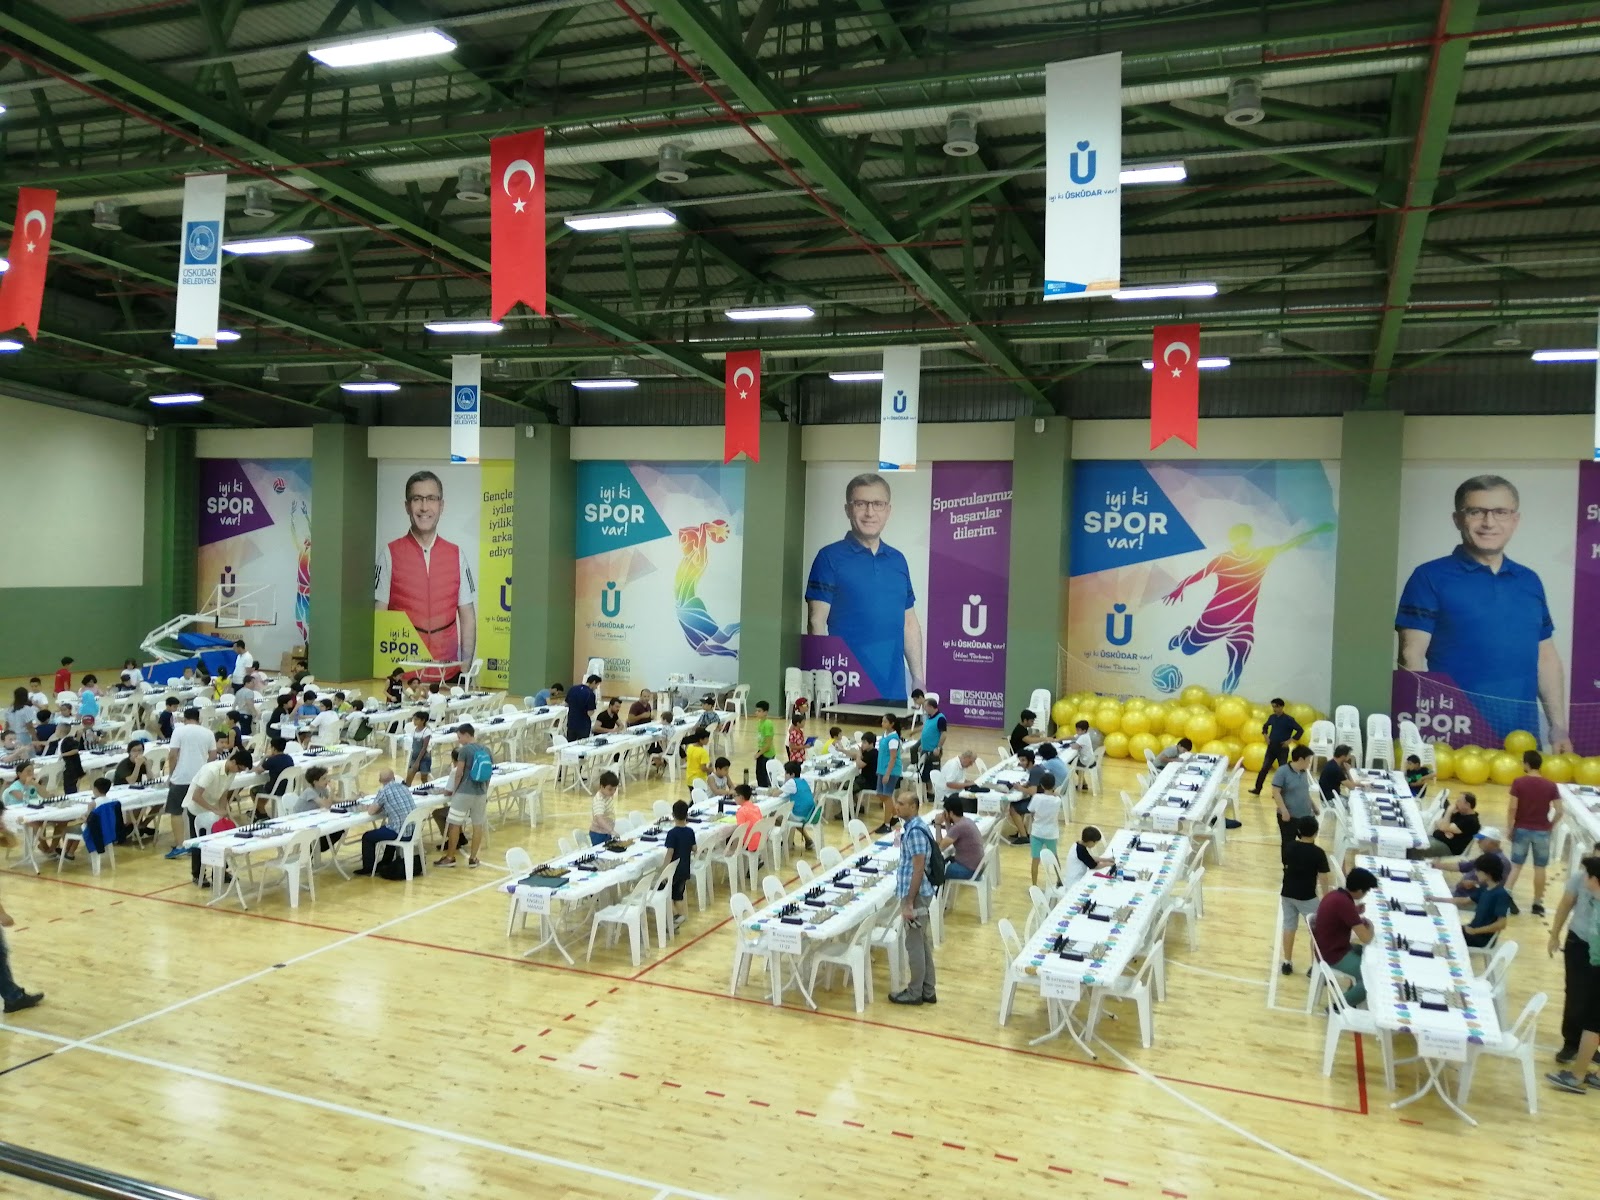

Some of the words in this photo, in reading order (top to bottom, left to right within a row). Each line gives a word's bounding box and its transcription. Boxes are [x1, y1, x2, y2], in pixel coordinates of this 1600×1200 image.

[1065, 189, 1102, 200] ÜSKÜDAR
[182, 268, 216, 277] ÜSKÜDAR
[219, 481, 230, 497] iyi
[233, 479, 243, 493] ki
[600, 485, 615, 503] iyi
[619, 483, 630, 498] ki
[207, 497, 254, 514] SPOR
[1106, 491, 1126, 511] iyi
[1132, 486, 1148, 505] ki
[220, 513, 241, 526] var!
[585, 504, 645, 523] SPOR
[950, 507, 1002, 525] başarılar
[602, 517, 628, 536] var!
[1083, 511, 1168, 534] SPOR
[953, 525, 997, 540] dilerim.
[1107, 533, 1144, 550] var!
[597, 621, 624, 629] ÜSKÜDAR
[390, 629, 400, 642] iyi
[402, 628, 410, 638] ki
[380, 641, 419, 655] SPOR
[951, 639, 957, 647] ki
[957, 639, 992, 649] ÜSKÜDAR
[603, 658, 630, 666] SKÜDAR
[822, 655, 835, 670] iyi
[838, 653, 848, 667] ki
[1100, 650, 1138, 660] ÜSKÜDAR
[964, 690, 1003, 701] ÜSKÜDAR
[1416, 696, 1434, 713] iyi
[1439, 693, 1453, 709] ki
[964, 699, 1003, 708] BELEDİYESİ
